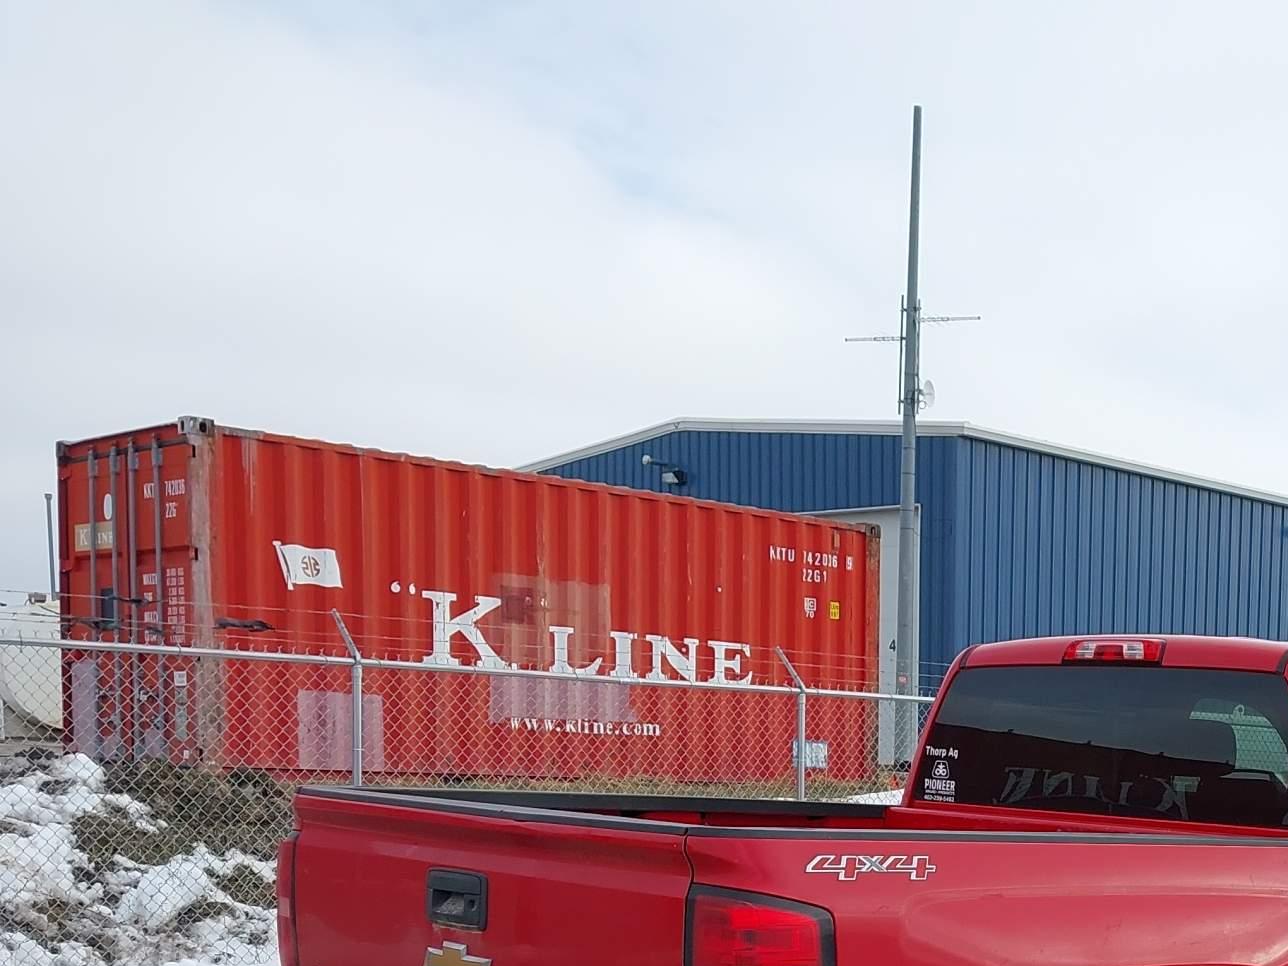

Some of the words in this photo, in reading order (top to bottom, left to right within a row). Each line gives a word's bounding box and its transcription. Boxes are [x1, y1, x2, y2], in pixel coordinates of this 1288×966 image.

[548, 625, 753, 685] LINE
[510, 717, 661, 737] www.kline.com
[925, 745, 947, 758] Thorp
[924, 778, 956, 792] PIONEER
